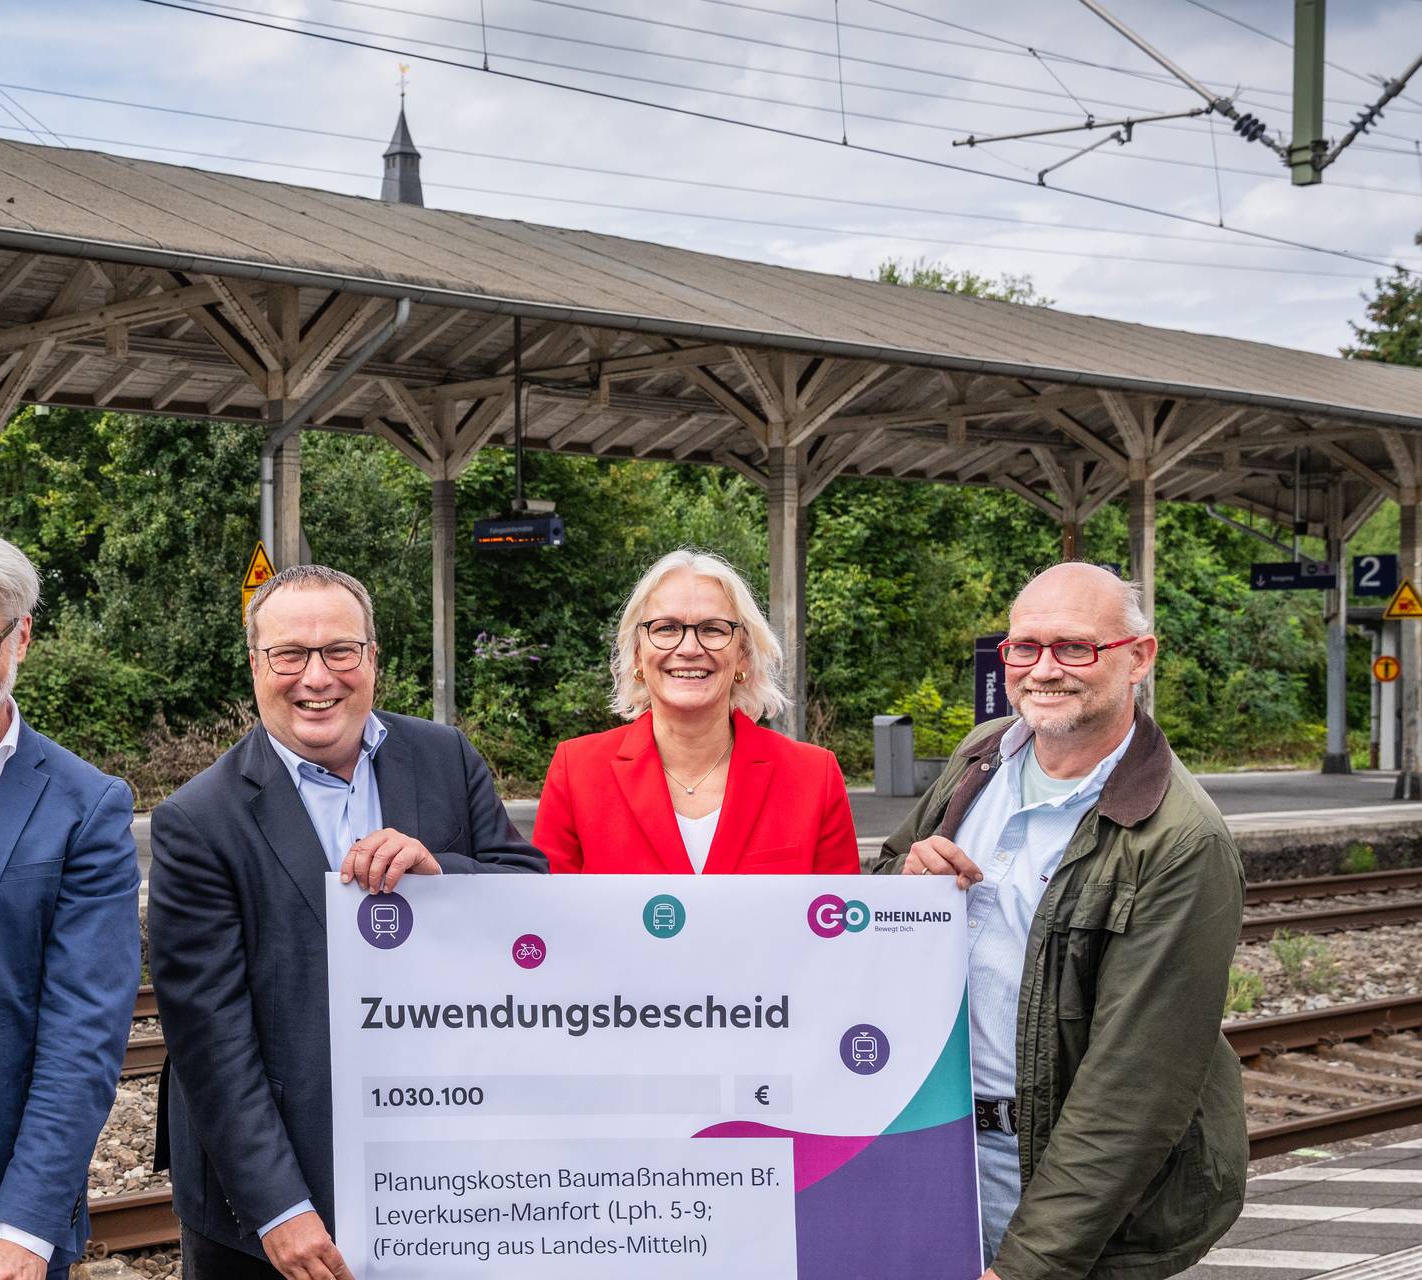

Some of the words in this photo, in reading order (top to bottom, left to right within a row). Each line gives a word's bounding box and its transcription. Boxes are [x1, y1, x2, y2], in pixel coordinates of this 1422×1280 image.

[1358, 556, 1382, 588] 2
[985, 670, 997, 715] Tickets
[874, 911, 952, 923] RHEINLAND
[874, 925, 899, 934] Bewegt
[361, 995, 789, 1037] Zuwendungsbescheid
[371, 1086, 484, 1107] 1.030.100
[754, 1085, 770, 1106] €
[374, 1170, 551, 1196] Planungskosten
[558, 1167, 743, 1188] Baumaßnahmen
[751, 1167, 780, 1187] Bf.
[375, 1201, 601, 1226] Leverkusen-Manfort
[608, 1199, 663, 1226] (Lph.
[670, 1200, 713, 1223] 5-9;
[373, 1236, 491, 1260] (Förderung
[497, 1240, 535, 1255] aus
[541, 1234, 708, 1257] Landes-Mitteln)
